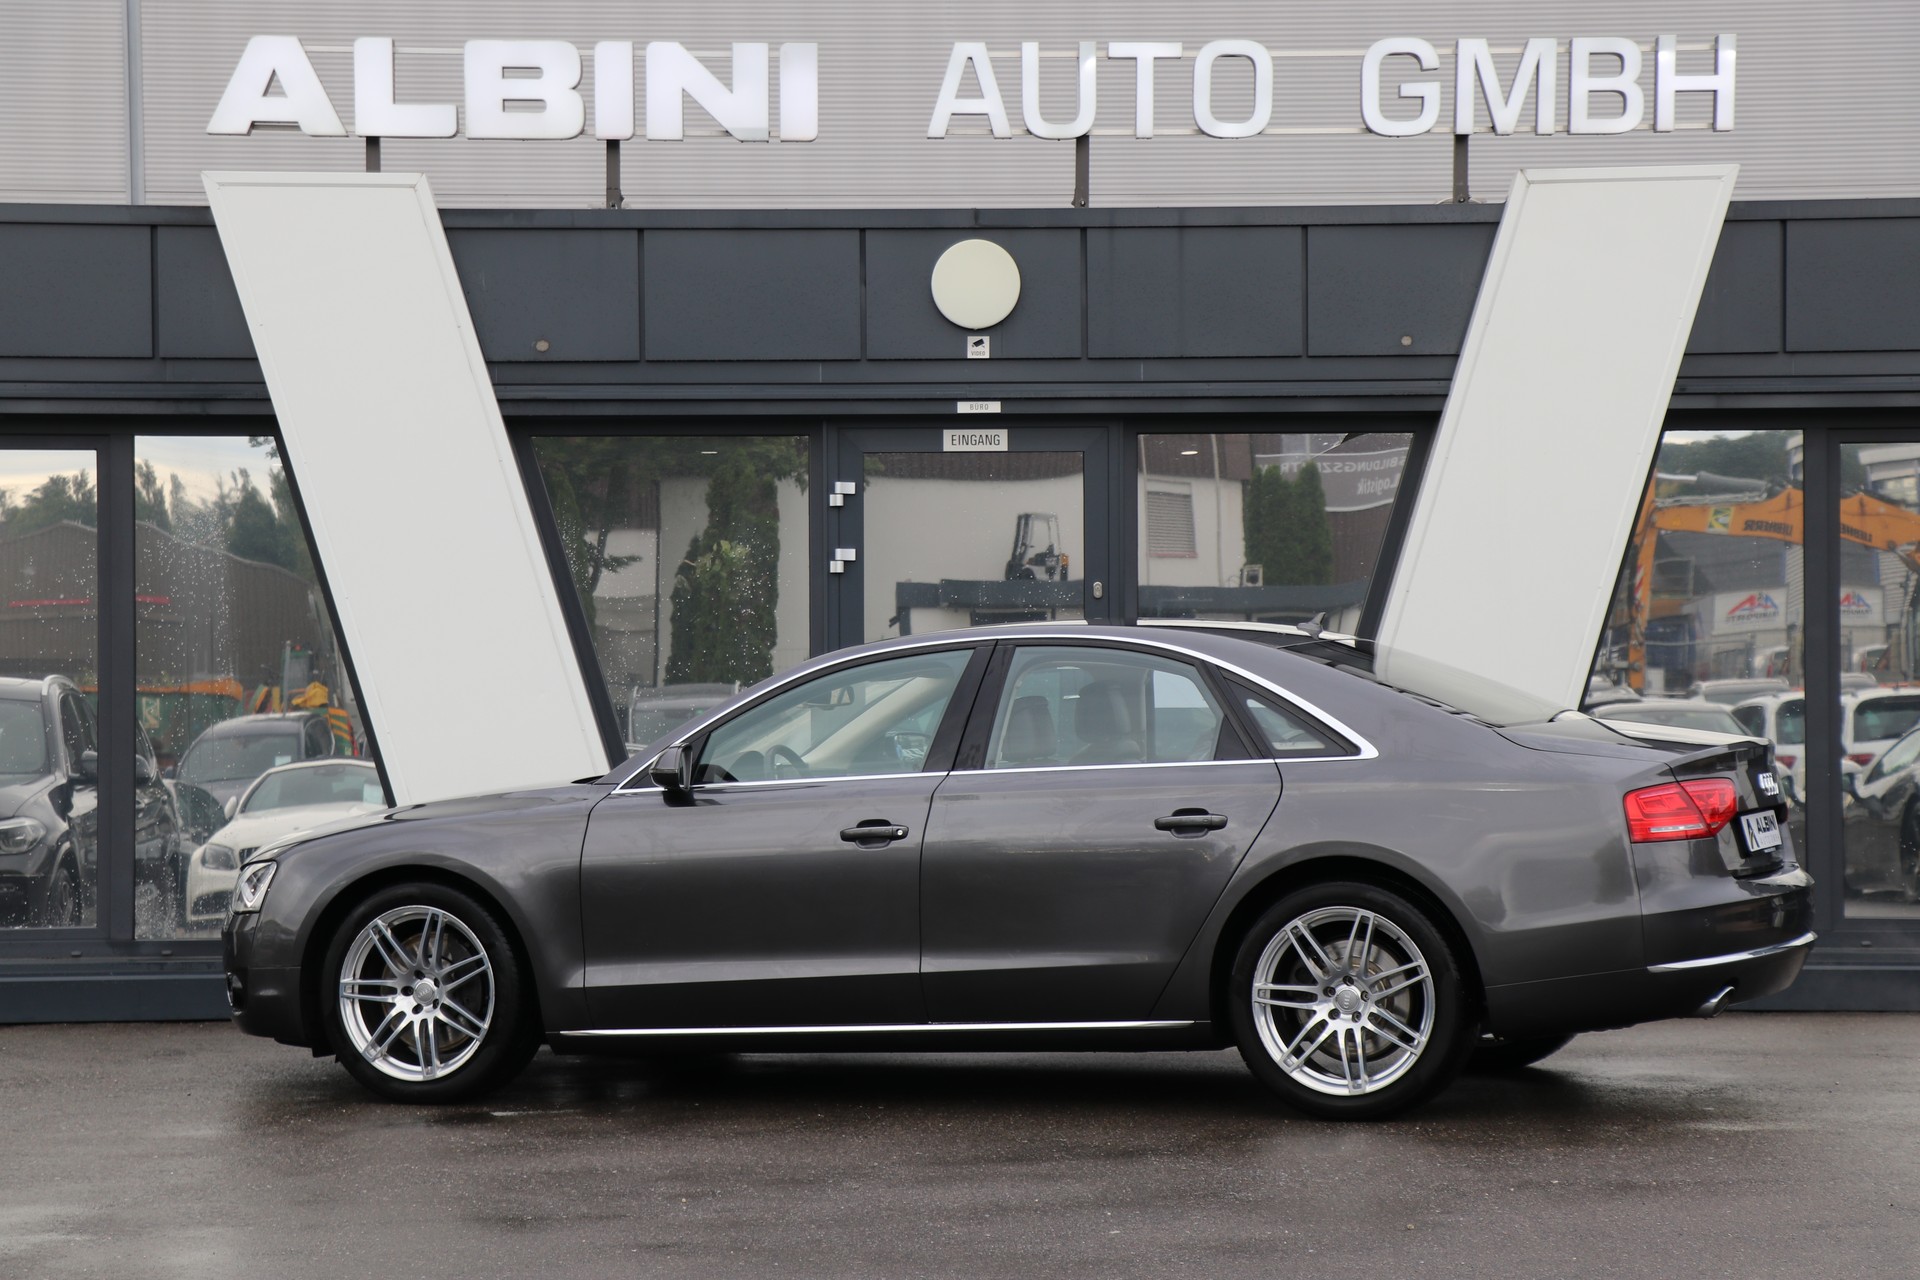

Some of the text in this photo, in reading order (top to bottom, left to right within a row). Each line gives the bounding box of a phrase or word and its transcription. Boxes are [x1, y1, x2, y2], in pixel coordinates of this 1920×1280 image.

[206, 33, 1738, 142] ALBINI AUTO GMBH
[969, 403, 989, 411] BÜRO
[951, 434, 1001, 446] EINGANG
